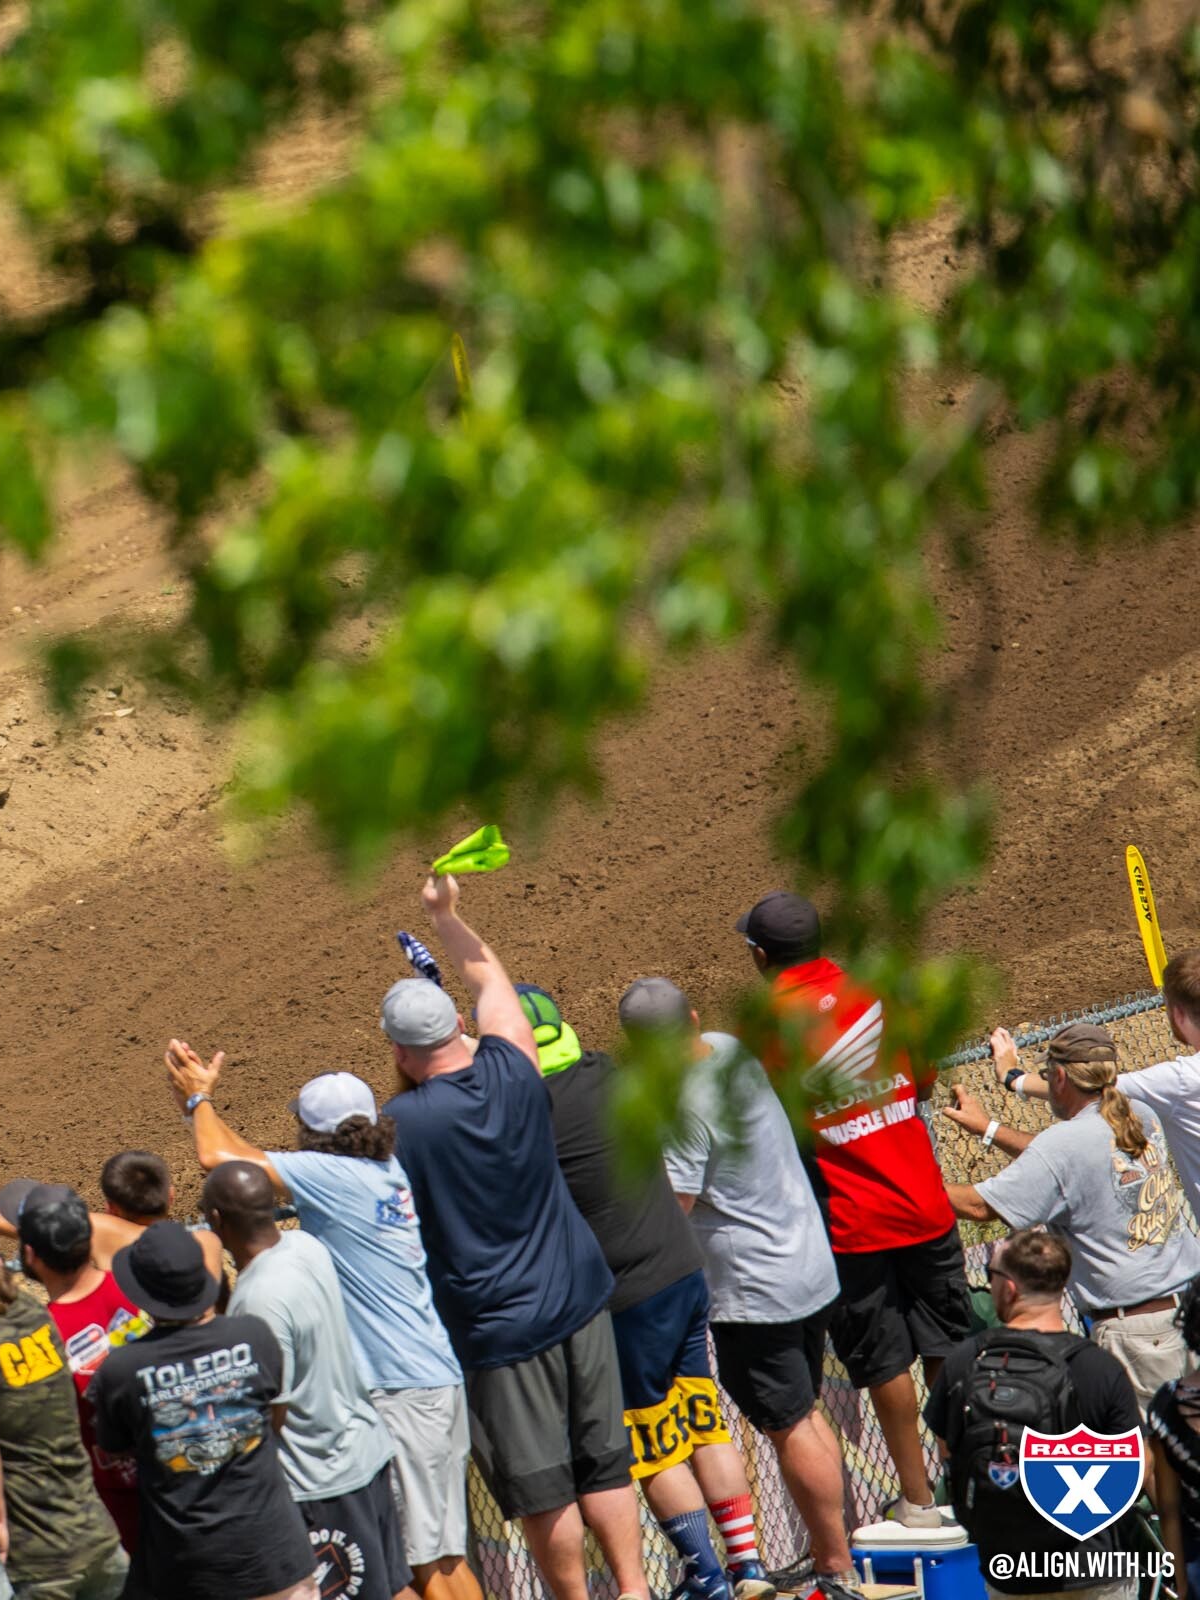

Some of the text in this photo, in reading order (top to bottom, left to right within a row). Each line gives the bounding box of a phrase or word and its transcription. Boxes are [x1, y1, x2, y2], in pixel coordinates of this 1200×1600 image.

[1133, 865, 1153, 924] ACERBIS
[814, 1073, 911, 1120] HONDA
[819, 1109, 886, 1145] MUSCLE
[136, 1342, 252, 1393] TOLEDO
[308, 1528, 330, 1546] DO
[344, 1542, 366, 1573] JUST
[345, 1575, 364, 1596] DO
